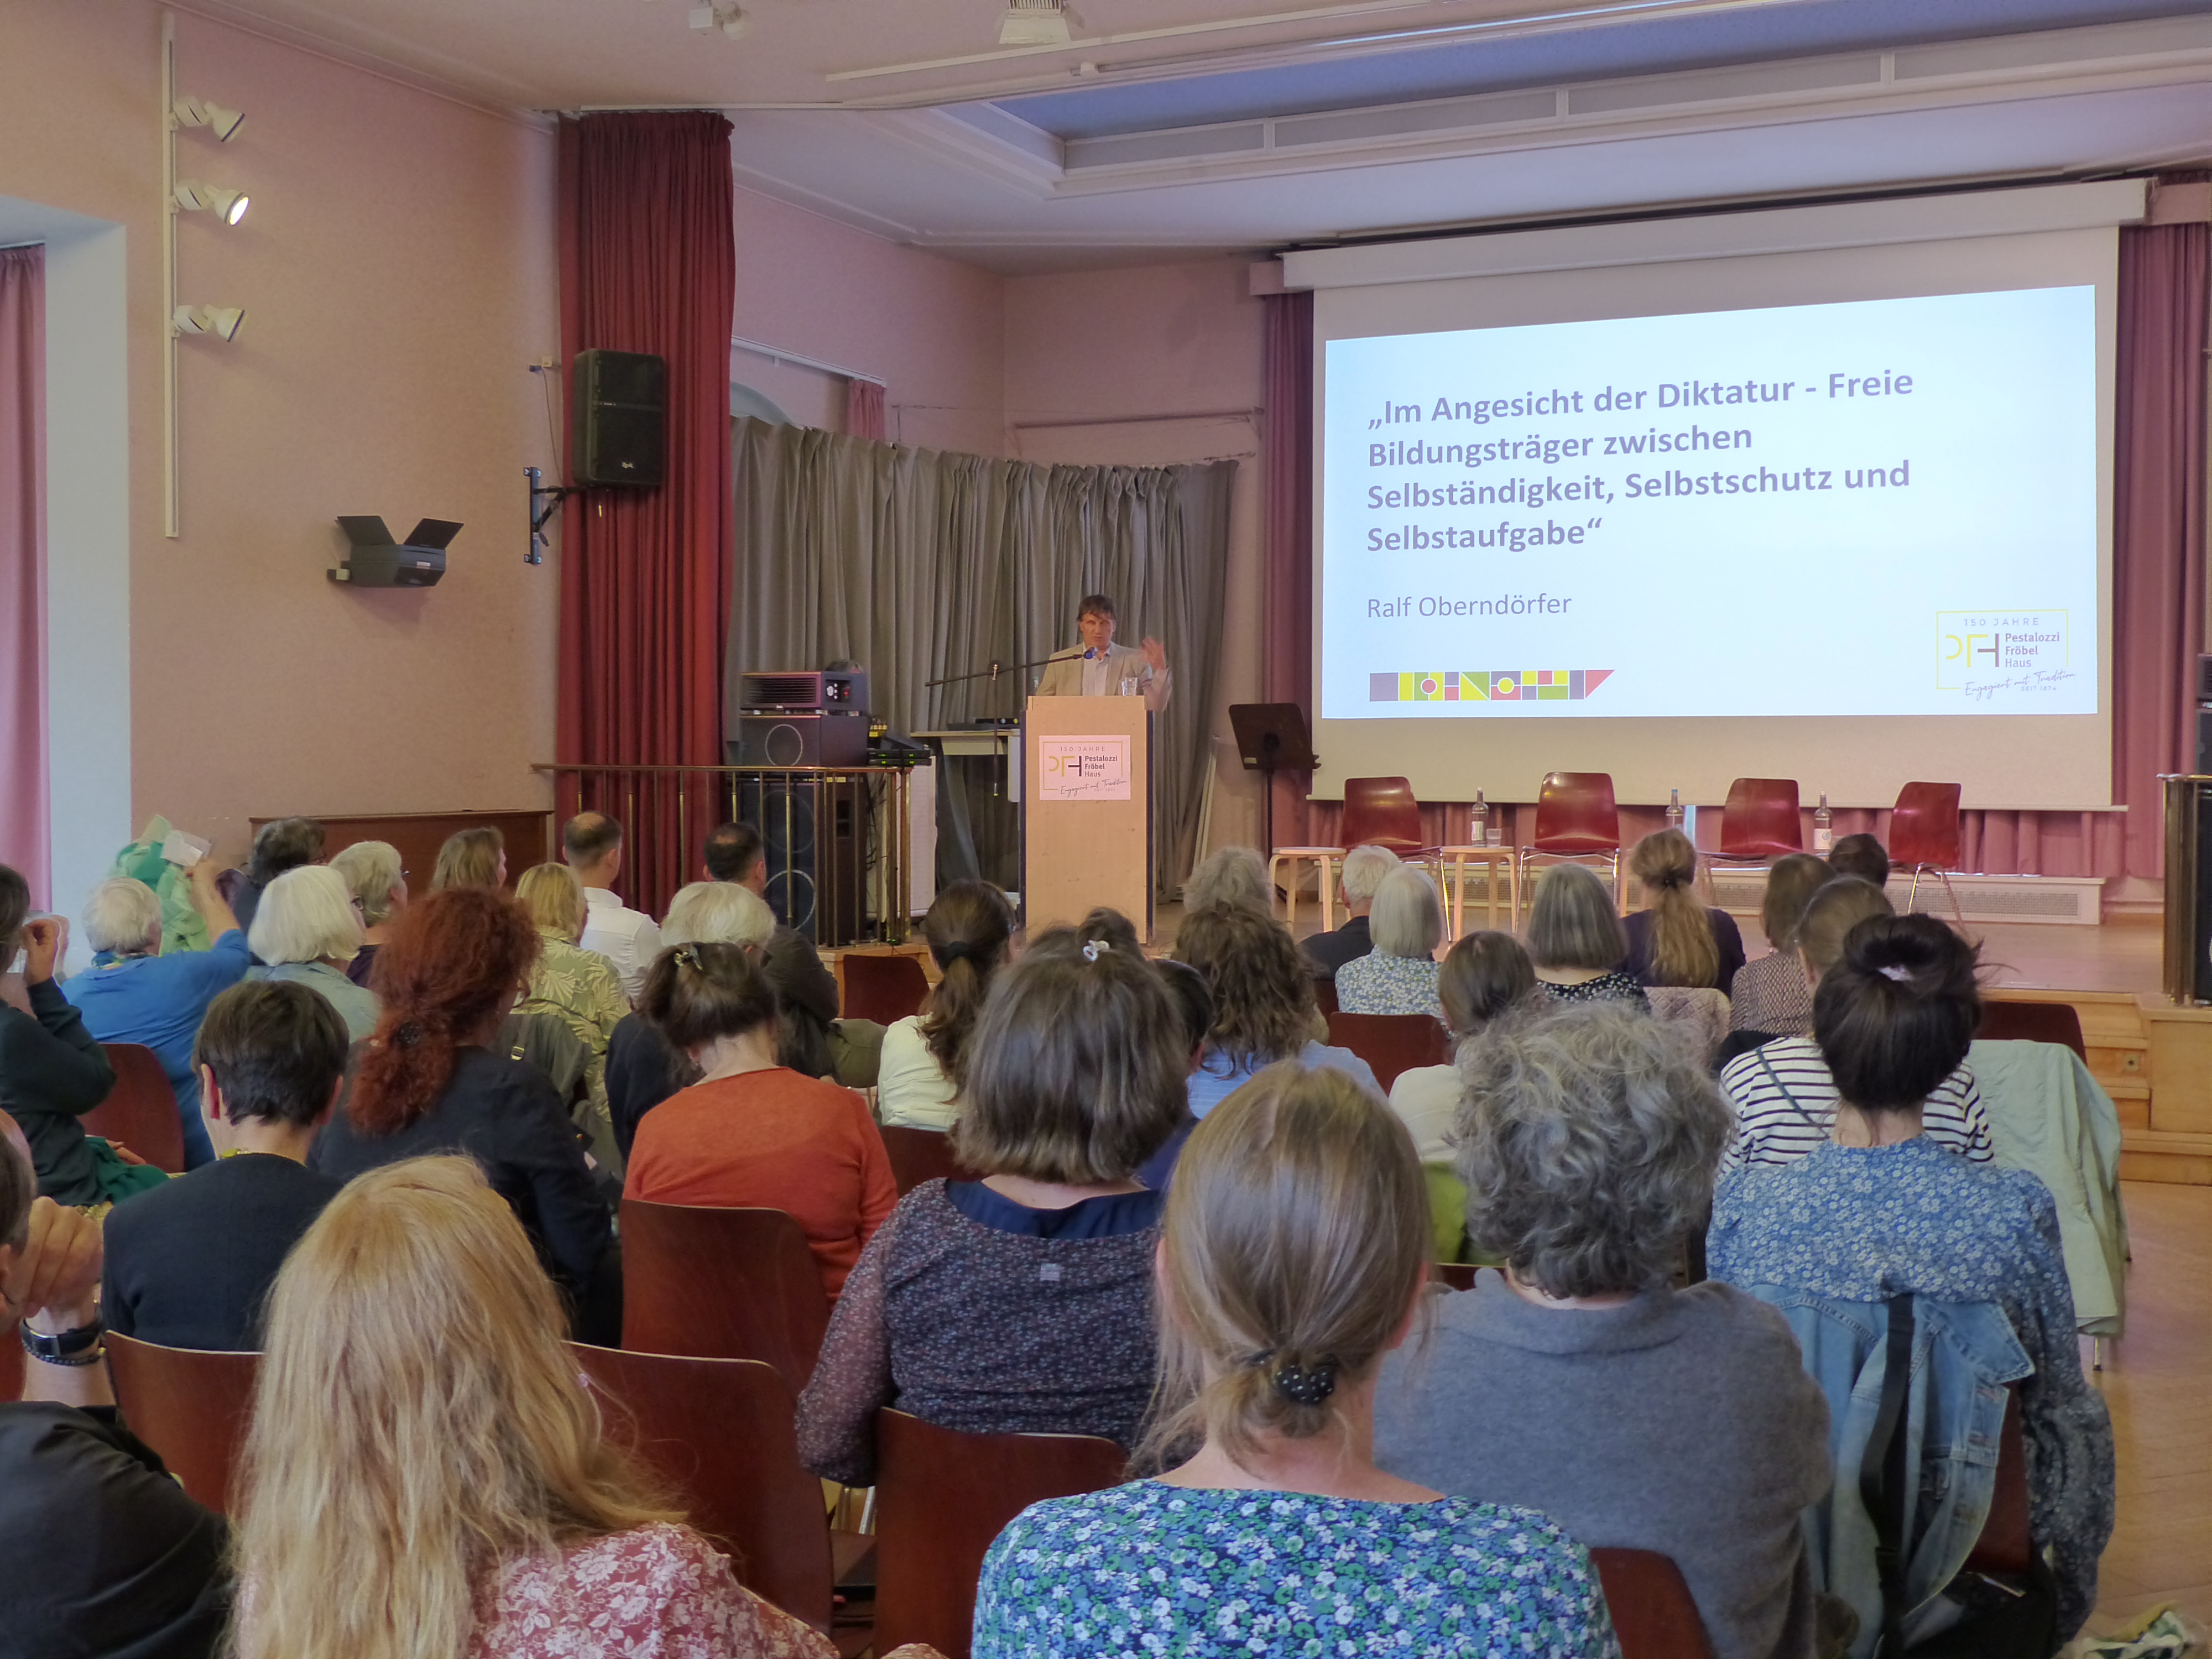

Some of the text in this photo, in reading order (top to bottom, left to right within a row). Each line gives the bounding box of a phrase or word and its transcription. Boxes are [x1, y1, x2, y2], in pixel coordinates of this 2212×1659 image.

[1368, 400, 1421, 430] „Im
[1431, 389, 1583, 425] Angesicht
[1594, 386, 1647, 411] der
[1658, 380, 1795, 408] Diktatur
[1829, 369, 1913, 398] Freie
[1369, 425, 1752, 468] Bildungsträger zwischen
[1368, 460, 1910, 509] Selbständigkeit, Selbstschutz und
[1368, 518, 1603, 552] Selbstaufgabe“
[1368, 593, 1572, 619] Ralf Oberndörfer
[1994, 618, 2039, 626] JAHRE
[2005, 632, 2060, 642] Pestalozzi
[2005, 646, 2038, 655] Fröbel
[2005, 659, 2032, 667] Haus
[1965, 677, 2012, 701] Engagiert
[2033, 669, 2077, 684] Tradition
[1102, 778, 1127, 788] Tradition
